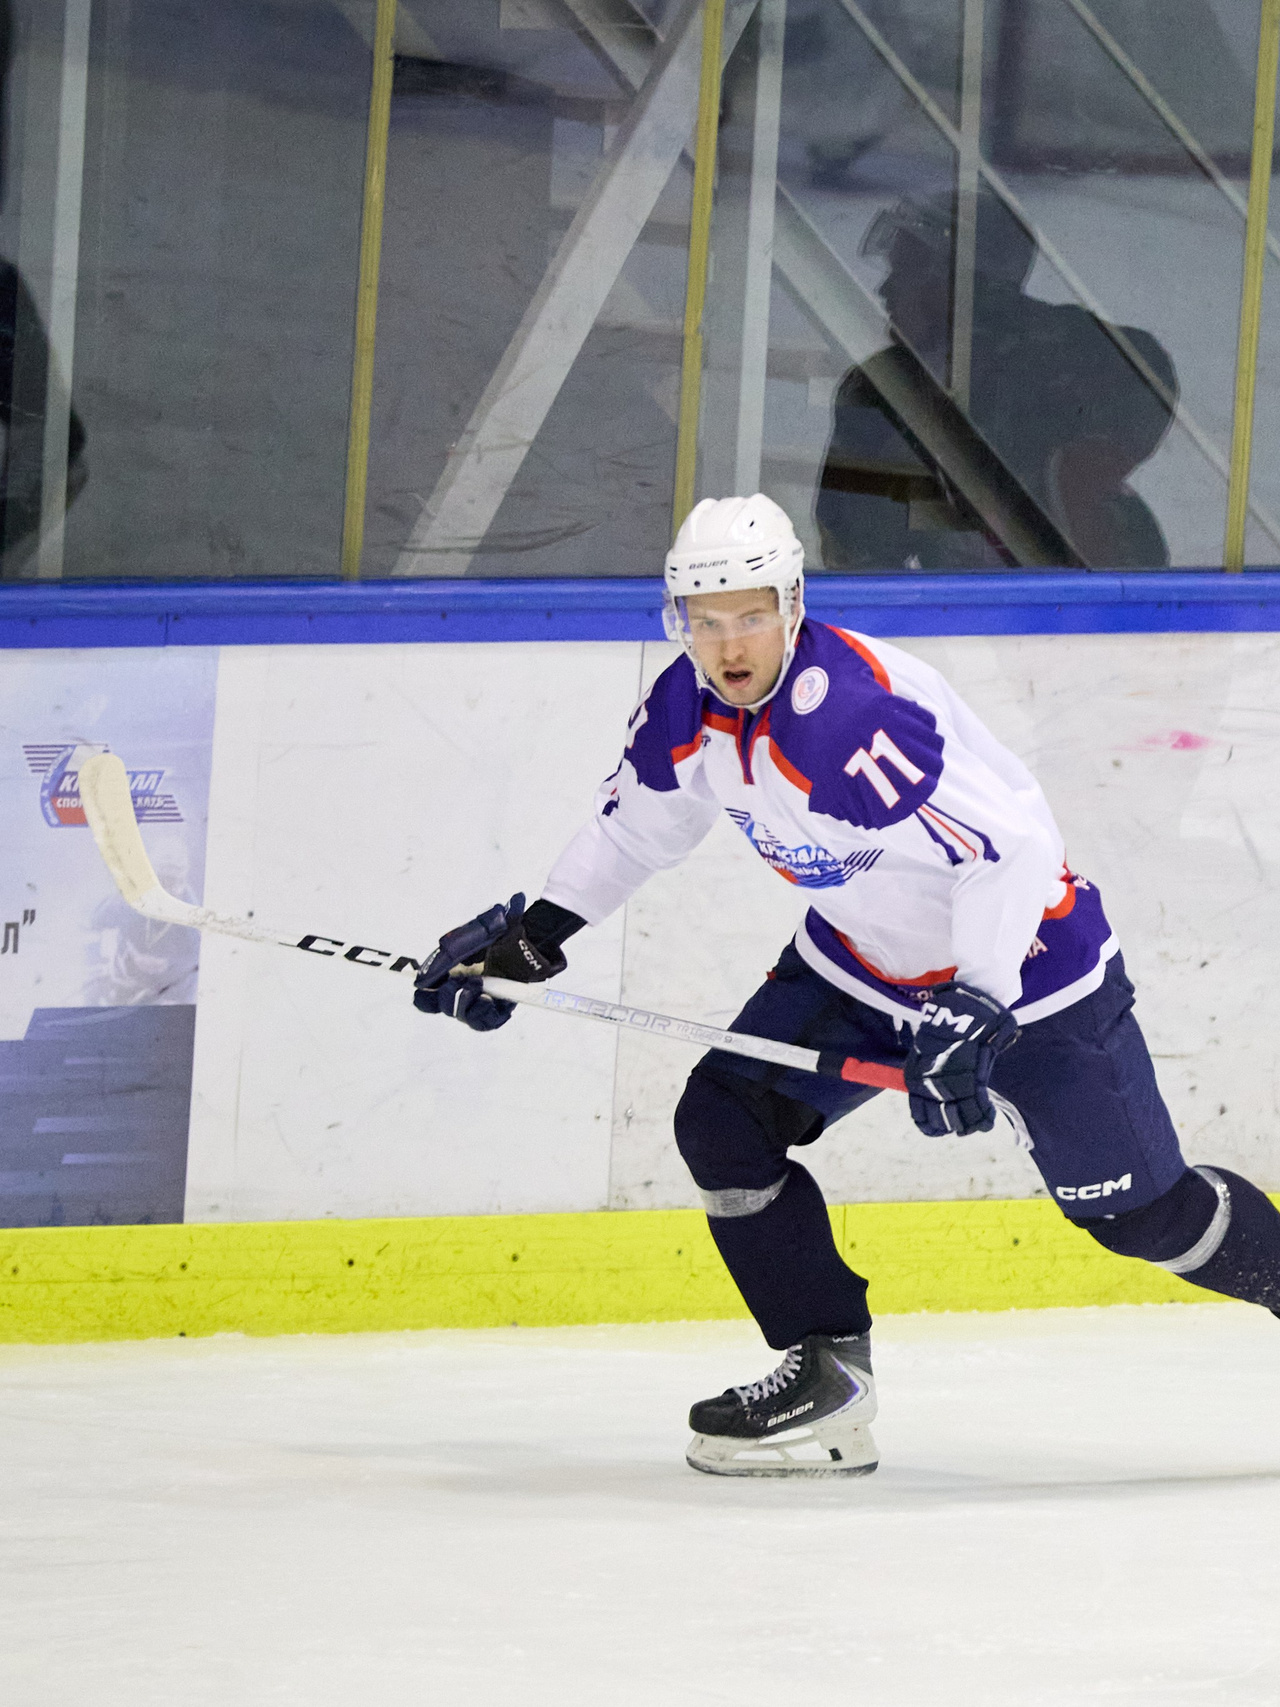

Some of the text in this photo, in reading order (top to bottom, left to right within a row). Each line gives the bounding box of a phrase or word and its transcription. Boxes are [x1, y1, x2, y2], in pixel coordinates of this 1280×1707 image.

[688, 559, 729, 570] BAUER
[842, 727, 926, 811] 71
[518, 939, 542, 971] CCM
[922, 1002, 975, 1034] CM
[1056, 1172, 1132, 1201] CCM
[767, 1401, 814, 1428] BAUER
